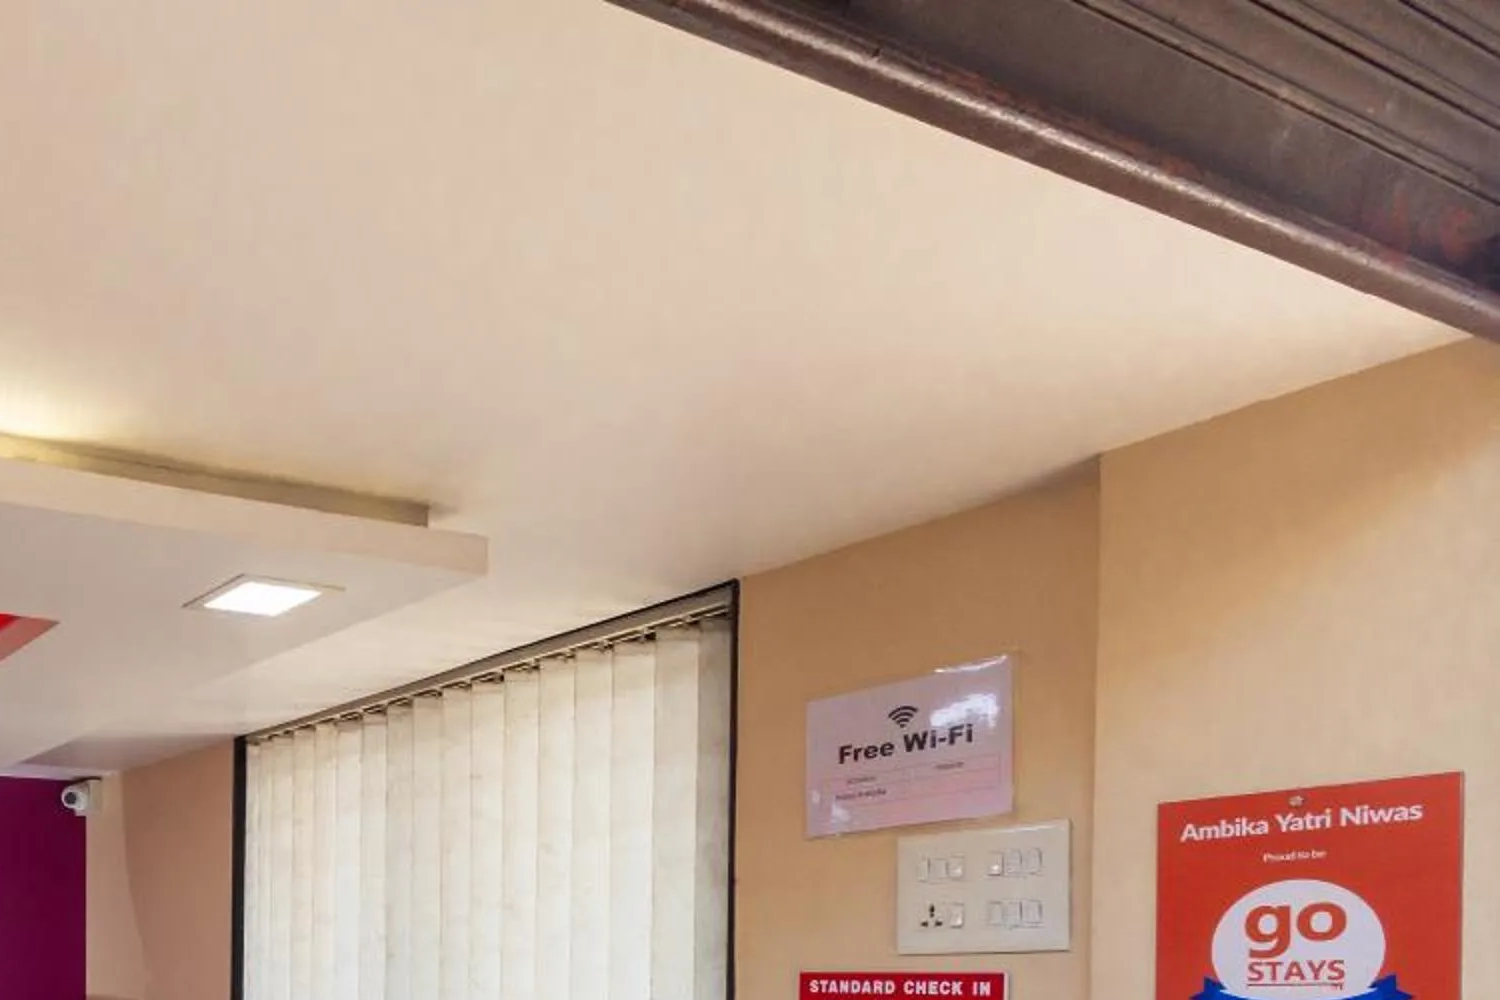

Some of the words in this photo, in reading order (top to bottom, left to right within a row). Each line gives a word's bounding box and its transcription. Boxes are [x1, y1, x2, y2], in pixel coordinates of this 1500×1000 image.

[838, 741, 894, 764] Free
[903, 724, 973, 753] Wi-Fi
[1180, 817, 1269, 843] Ambika
[1274, 808, 1332, 834] Yatri
[1339, 803, 1424, 827] Niwas
[1244, 901, 1347, 959] go
[809, 979, 896, 995] STANDARD
[903, 981, 963, 996] CHECK
[972, 981, 991, 997] IN
[1247, 959, 1345, 982] STAYS
